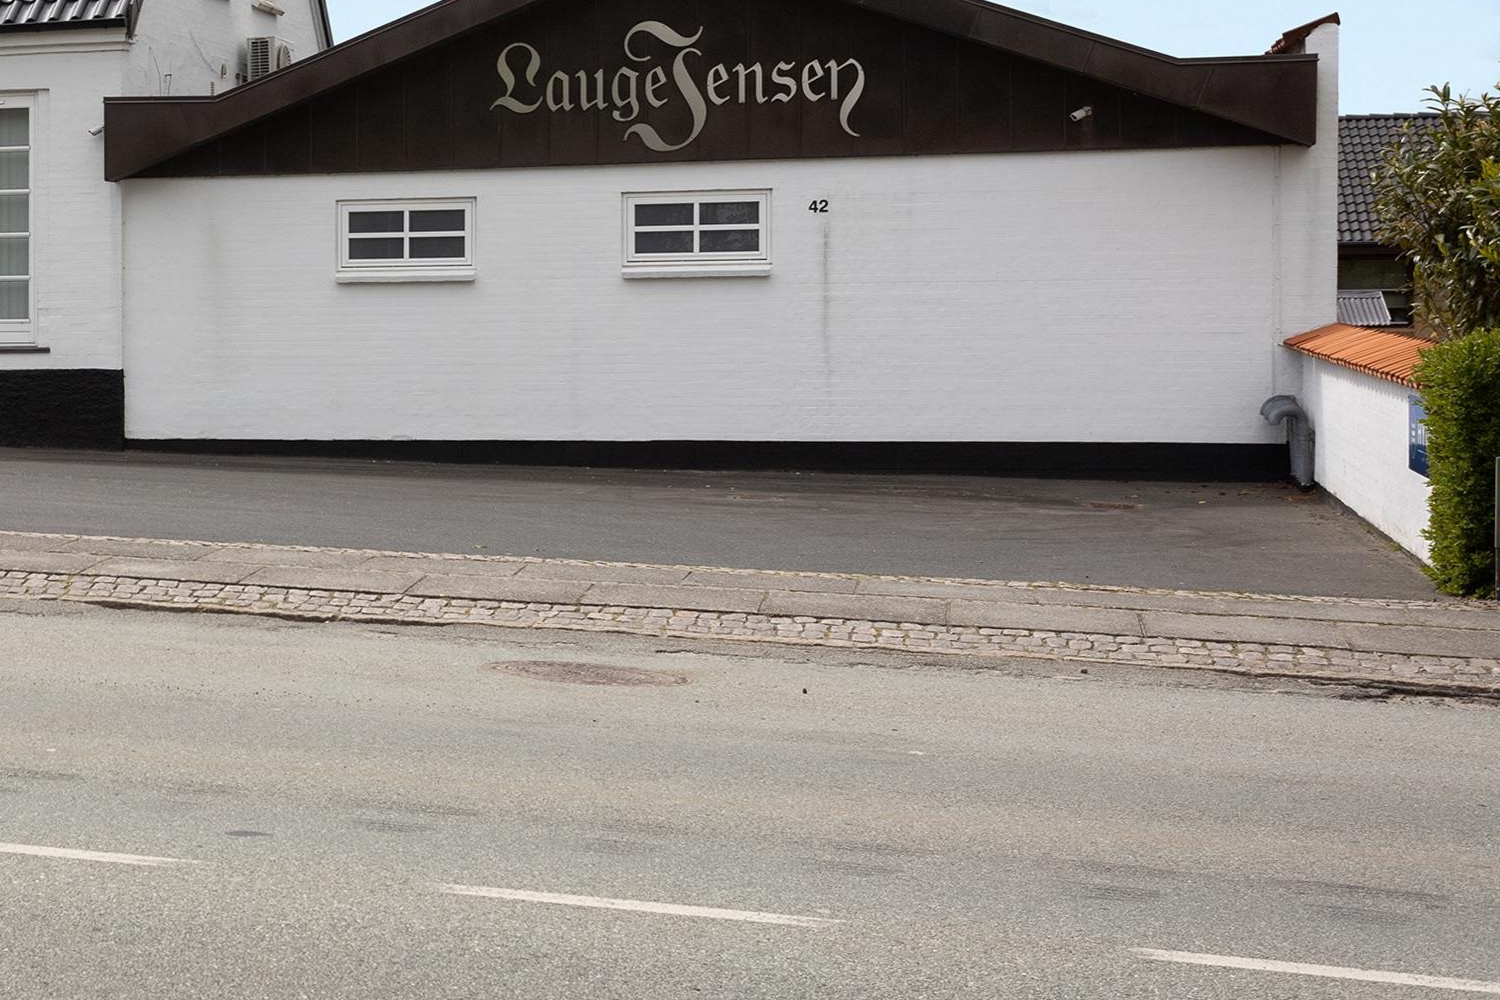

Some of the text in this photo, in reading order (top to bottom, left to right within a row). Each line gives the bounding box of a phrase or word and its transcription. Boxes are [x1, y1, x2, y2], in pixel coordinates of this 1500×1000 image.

[490, 20, 865, 152] Lauge Jensen
[808, 199, 829, 213] 42
